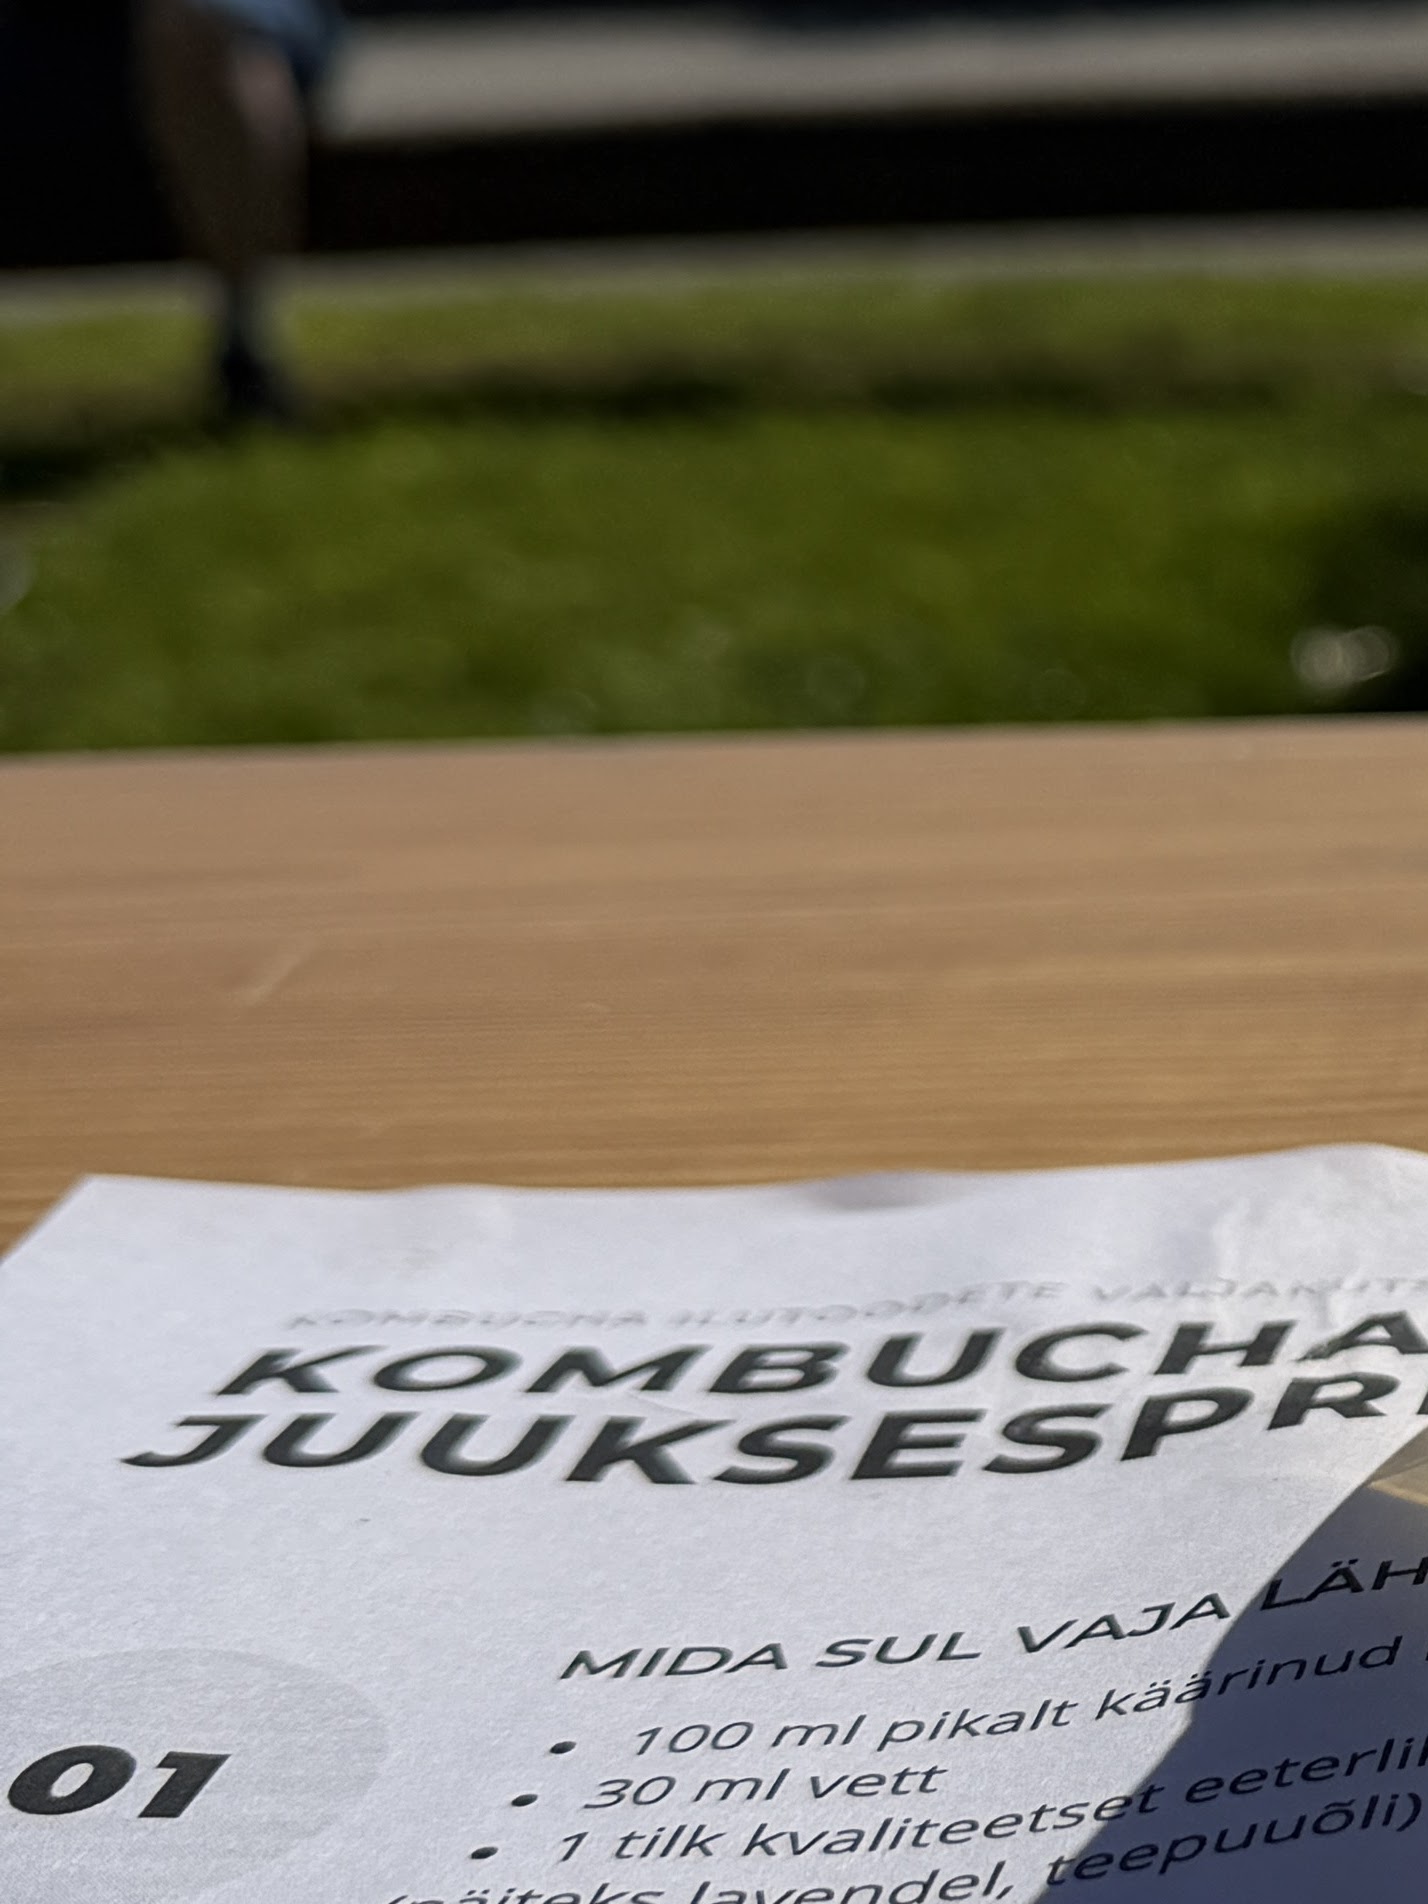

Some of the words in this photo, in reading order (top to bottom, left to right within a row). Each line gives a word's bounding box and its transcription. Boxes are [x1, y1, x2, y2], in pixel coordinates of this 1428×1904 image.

[559, 1641, 789, 1681] MIDA
[816, 1631, 983, 1671] SUL
[1015, 1593, 1232, 1655] VAJA
[634, 1722, 755, 1757] 100
[770, 1713, 866, 1751] ml
[876, 1698, 1079, 1753] pikalt
[1095, 1636, 1403, 1724] käärinud
[6, 1744, 232, 1820] 01
[557, 1831, 590, 1864] 1
[614, 1822, 725, 1861] tilk
[742, 1779, 1161, 1859] kvaliteetset
[583, 1776, 679, 1810] 30
[693, 1767, 790, 1806] ml
[809, 1760, 947, 1800] vett
[1045, 1791, 1424, 1890] teepuuõli)
